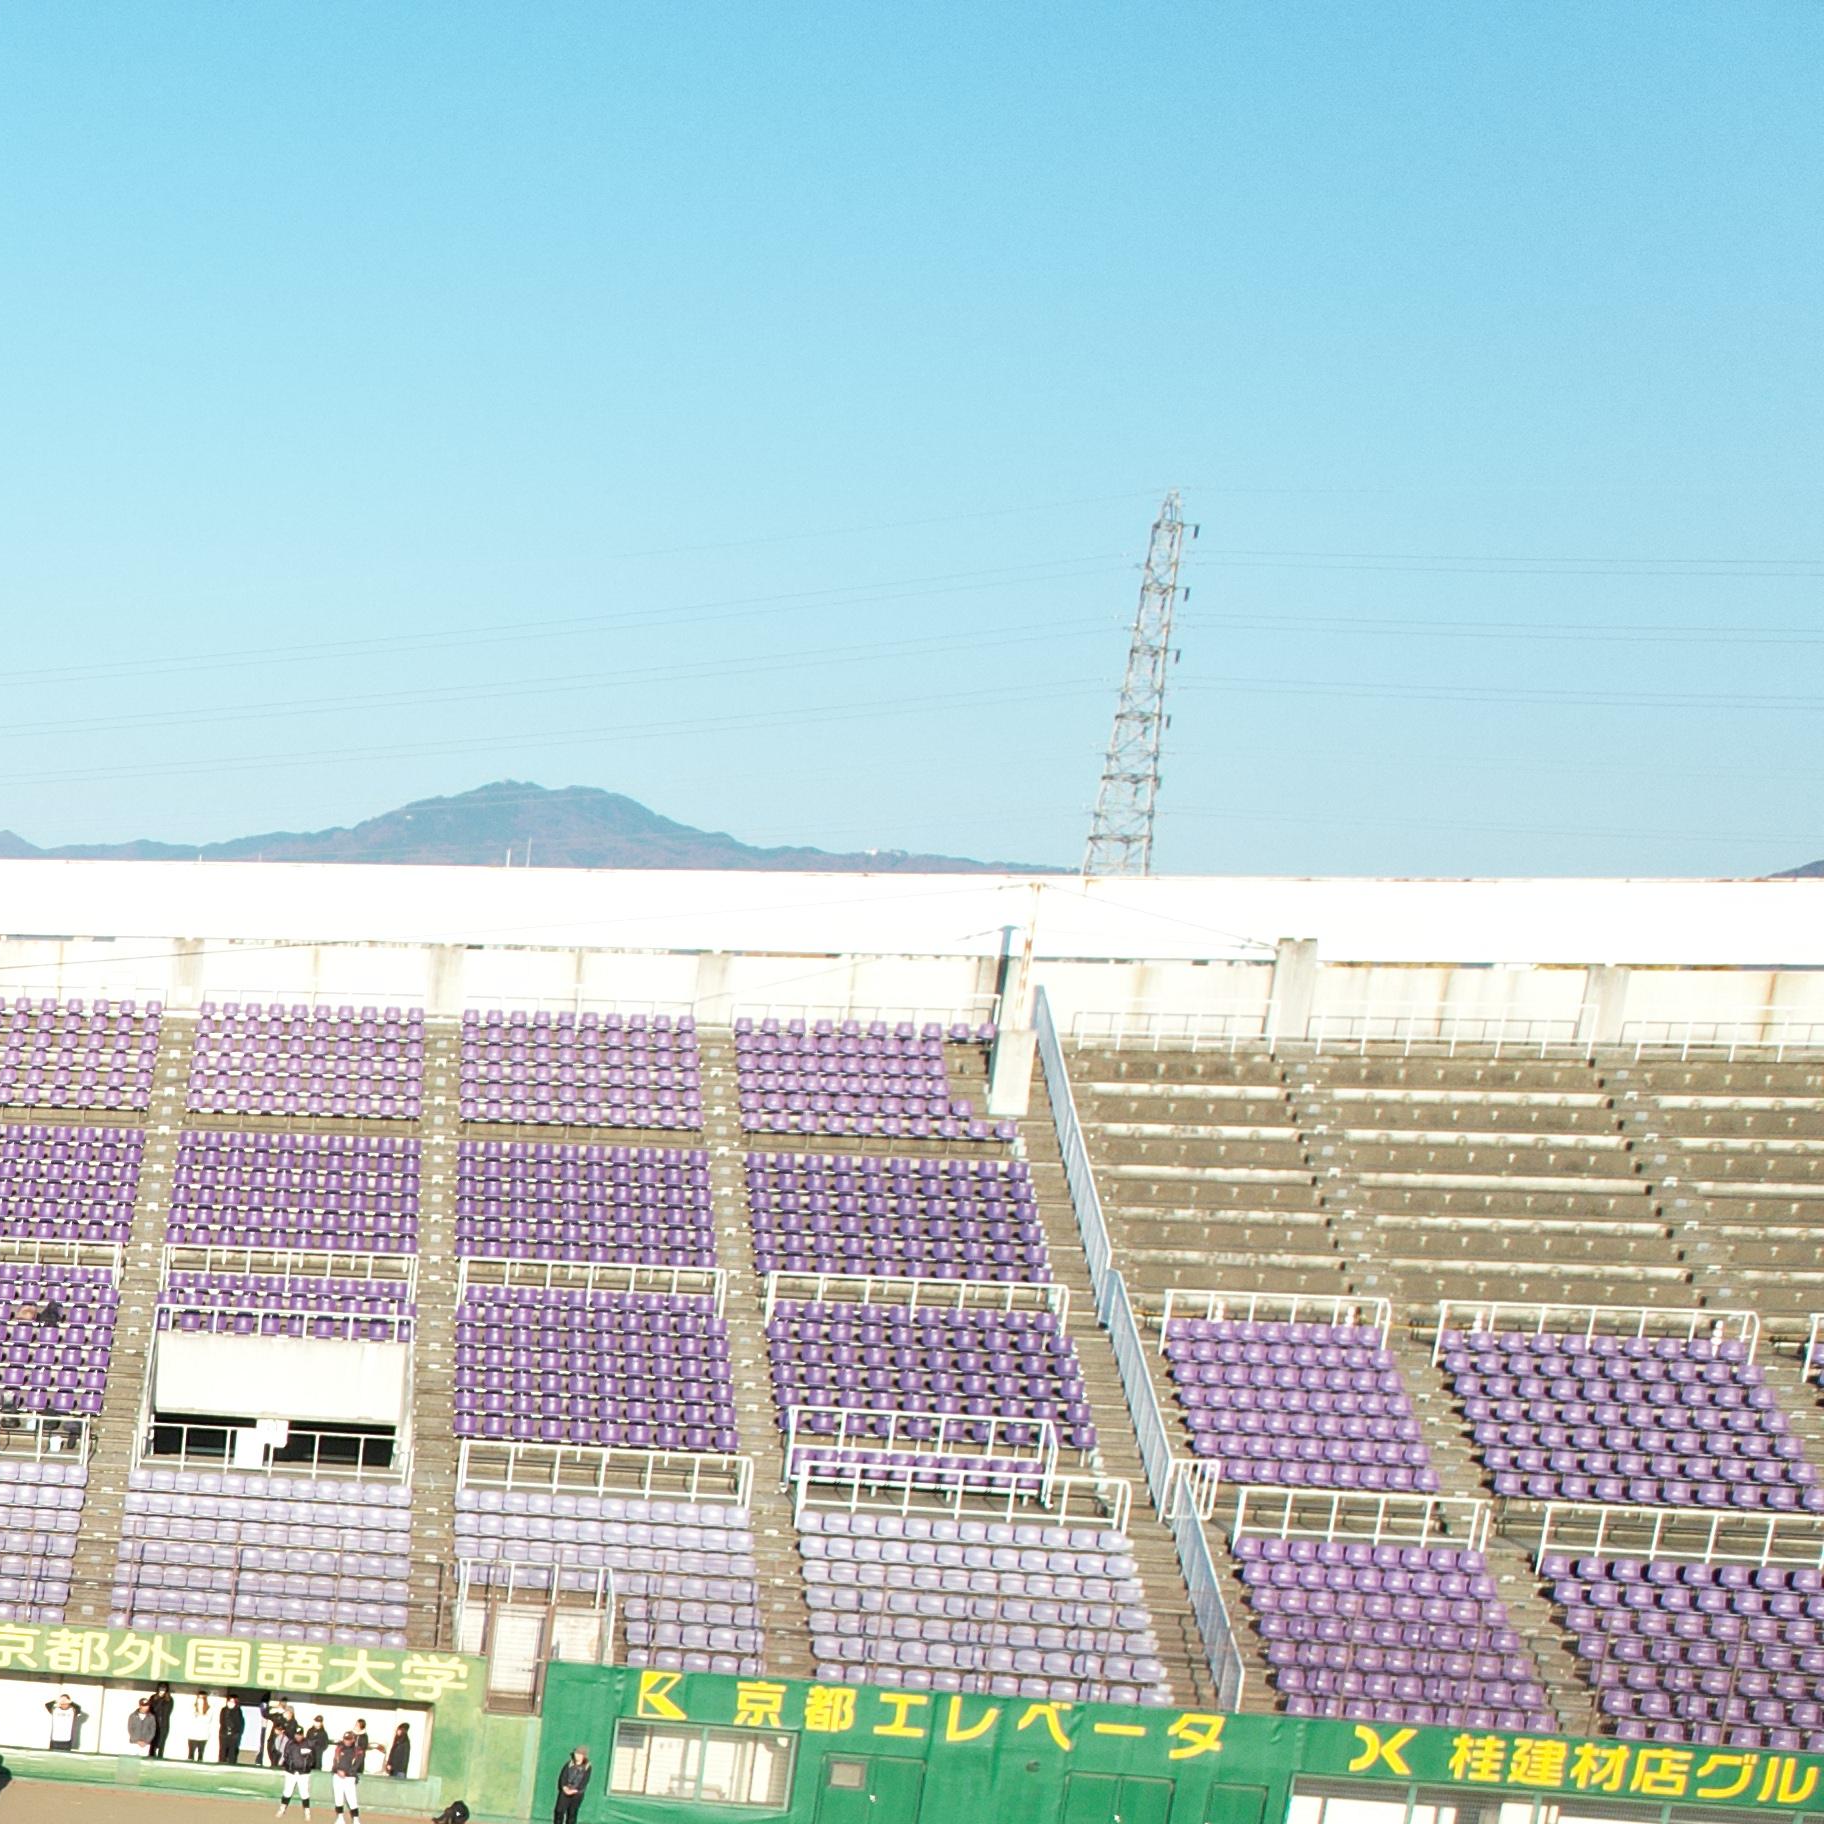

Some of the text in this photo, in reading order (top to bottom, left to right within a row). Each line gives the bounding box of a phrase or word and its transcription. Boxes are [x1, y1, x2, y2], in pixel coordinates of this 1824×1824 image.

[732, 1681, 1229, 1760] 京都エレベータ
